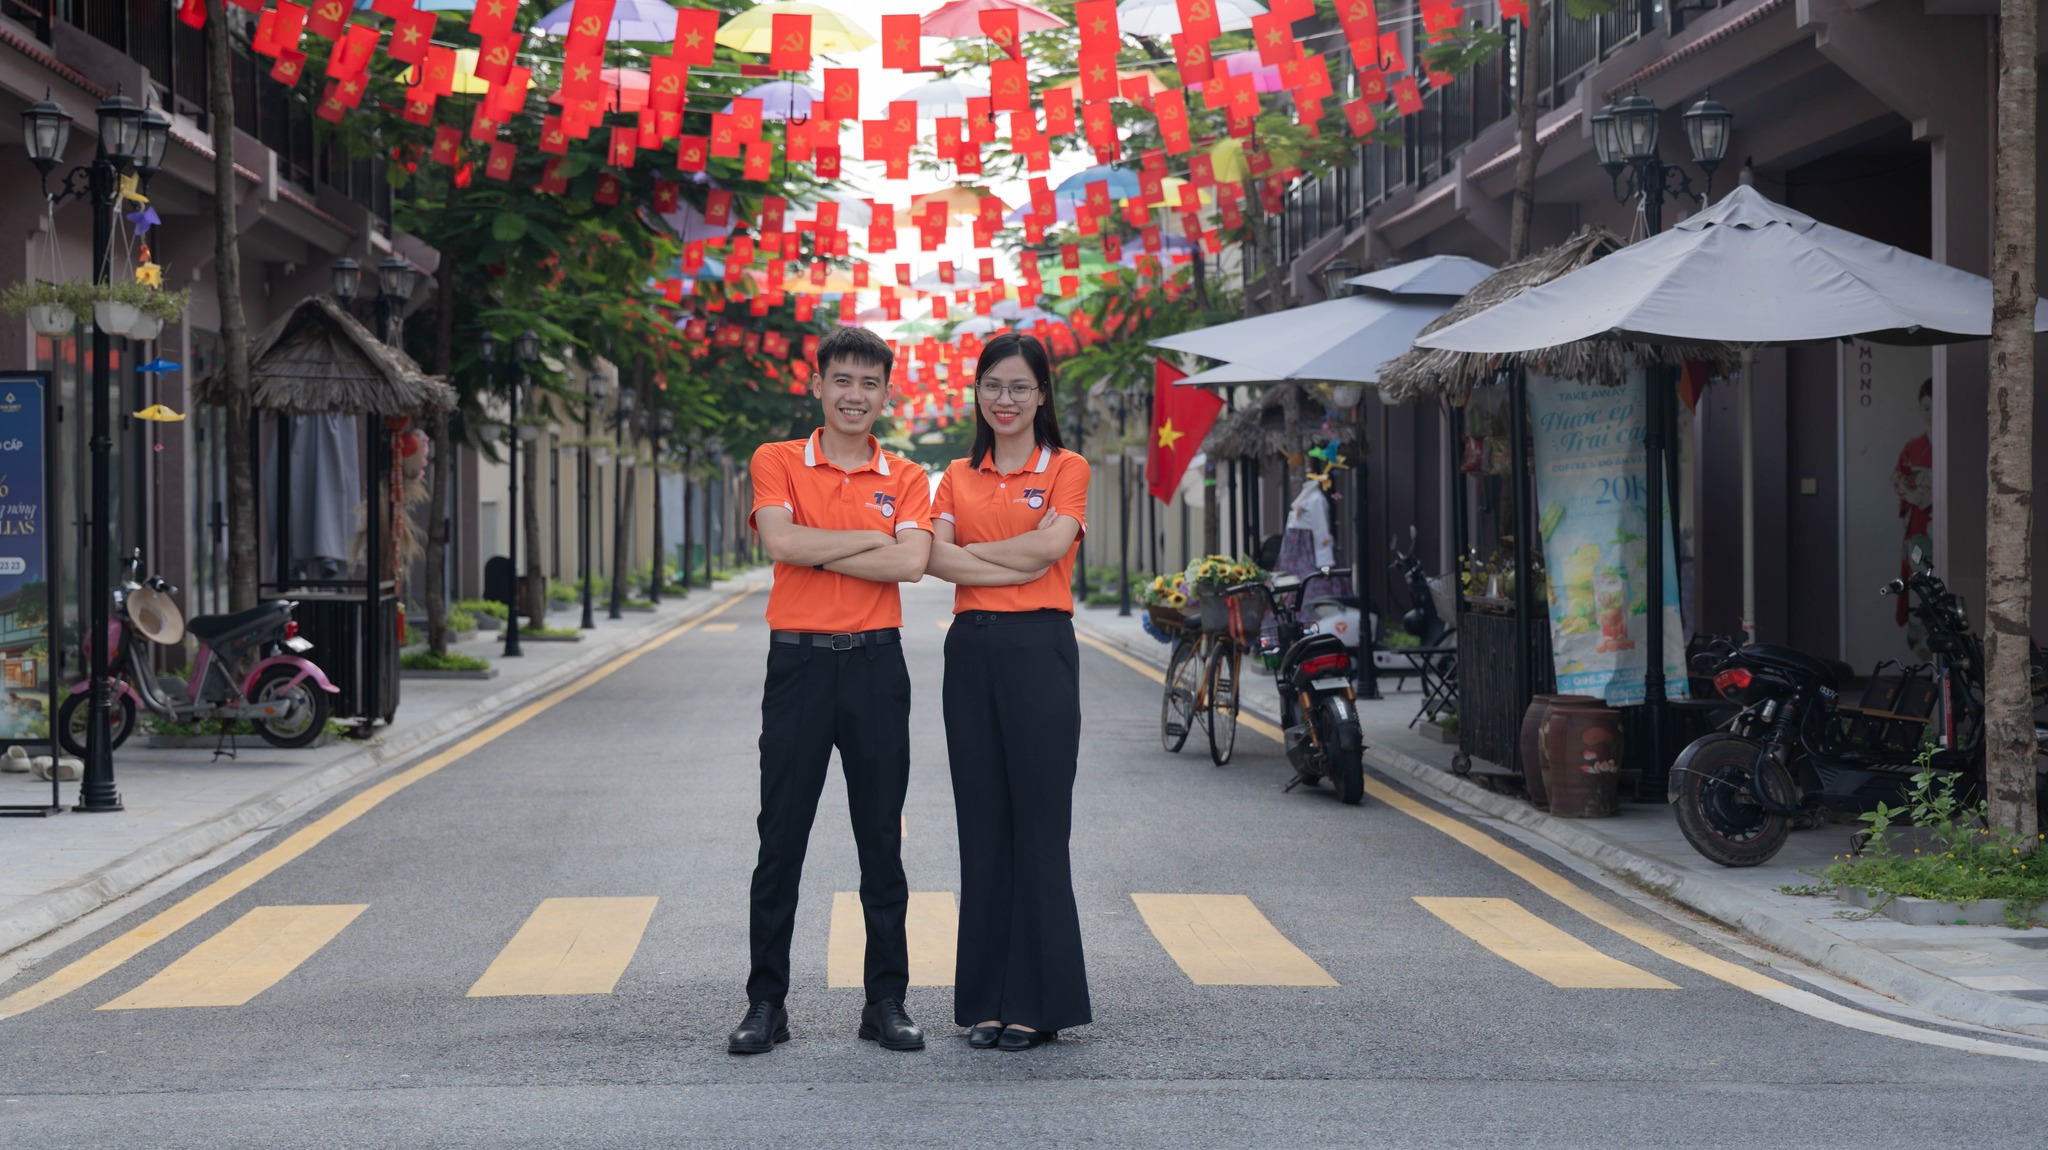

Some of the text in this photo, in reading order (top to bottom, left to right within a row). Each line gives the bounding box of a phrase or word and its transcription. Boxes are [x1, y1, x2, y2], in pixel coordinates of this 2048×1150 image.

[1859, 345, 1872, 408] MONO
[1559, 388, 1626, 402] TAKE AWAY
[1540, 399, 1633, 432] Nước ép
[3, 438, 24, 452] CẤP
[1560, 425, 1611, 452] Trái
[1552, 462, 1587, 472] COFFEE
[874, 490, 896, 518] 15
[1023, 486, 1046, 509] 15
[0, 520, 35, 535] LLAS
[11, 560, 21, 571] 23
